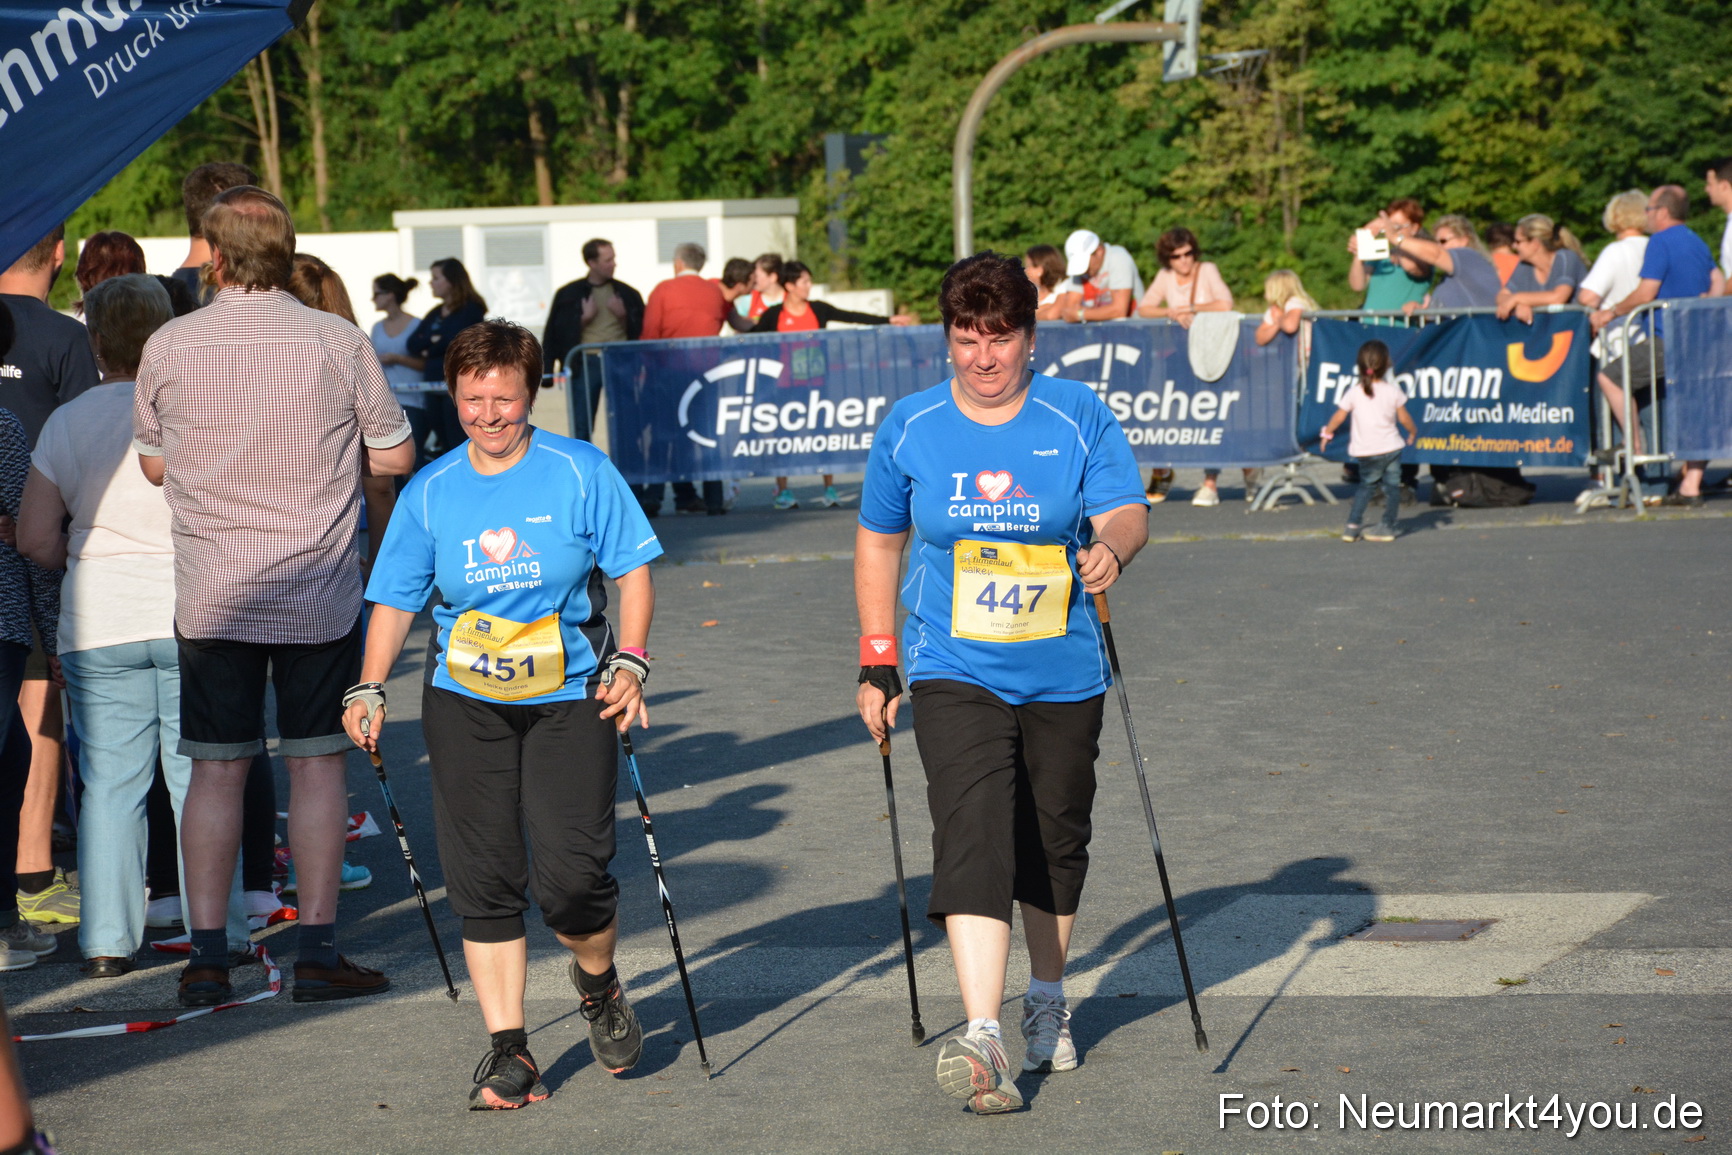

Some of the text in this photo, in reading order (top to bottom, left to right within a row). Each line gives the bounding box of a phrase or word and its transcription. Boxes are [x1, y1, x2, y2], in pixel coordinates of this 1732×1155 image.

[83, 19, 165, 99] Druck
[1316, 362, 1503, 405] Frihmann
[716, 390, 886, 435] Fischer
[1084, 380, 1240, 421] ischer
[1423, 402, 1574, 424] Druck und Medien
[733, 432, 874, 457] AUTOMOBILE
[950, 473, 968, 501] I
[948, 500, 1040, 522] camping
[1006, 522, 1040, 532] Berger
[462, 539, 478, 569] I
[972, 556, 1013, 567] firmenlauf
[465, 560, 541, 583] camping
[514, 579, 542, 589] Berger
[976, 581, 1047, 615] 447
[467, 626, 504, 643] firmenlauf
[1005, 621, 1029, 629] Zunner
[469, 653, 535, 682] 451
